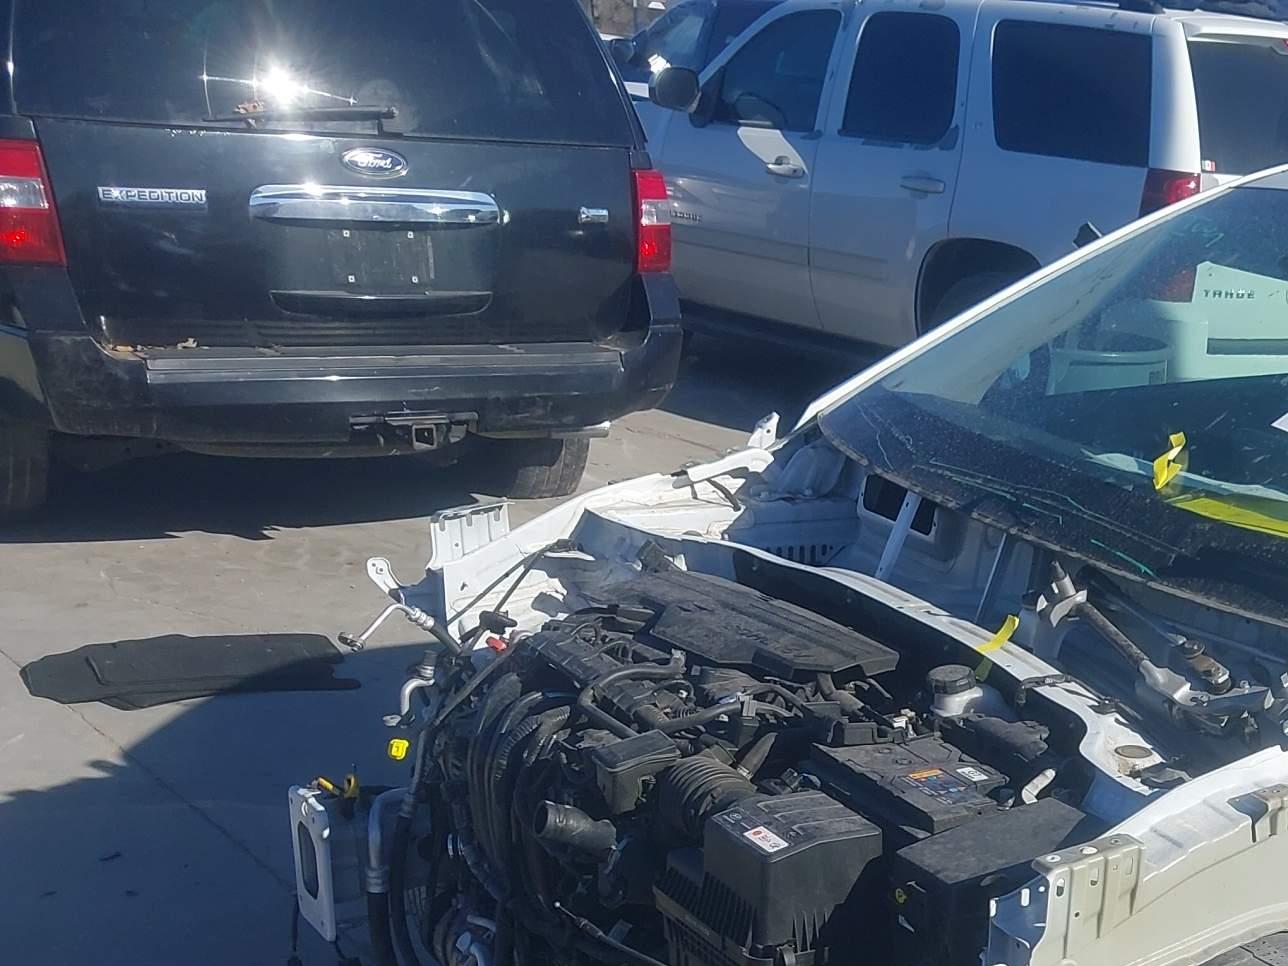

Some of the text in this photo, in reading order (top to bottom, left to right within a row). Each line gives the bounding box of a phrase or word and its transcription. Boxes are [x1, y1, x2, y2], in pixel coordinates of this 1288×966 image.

[351, 152, 393, 168] Ford
[101, 187, 205, 202] EXPEDITION
[1203, 289, 1256, 300] TAHOE
